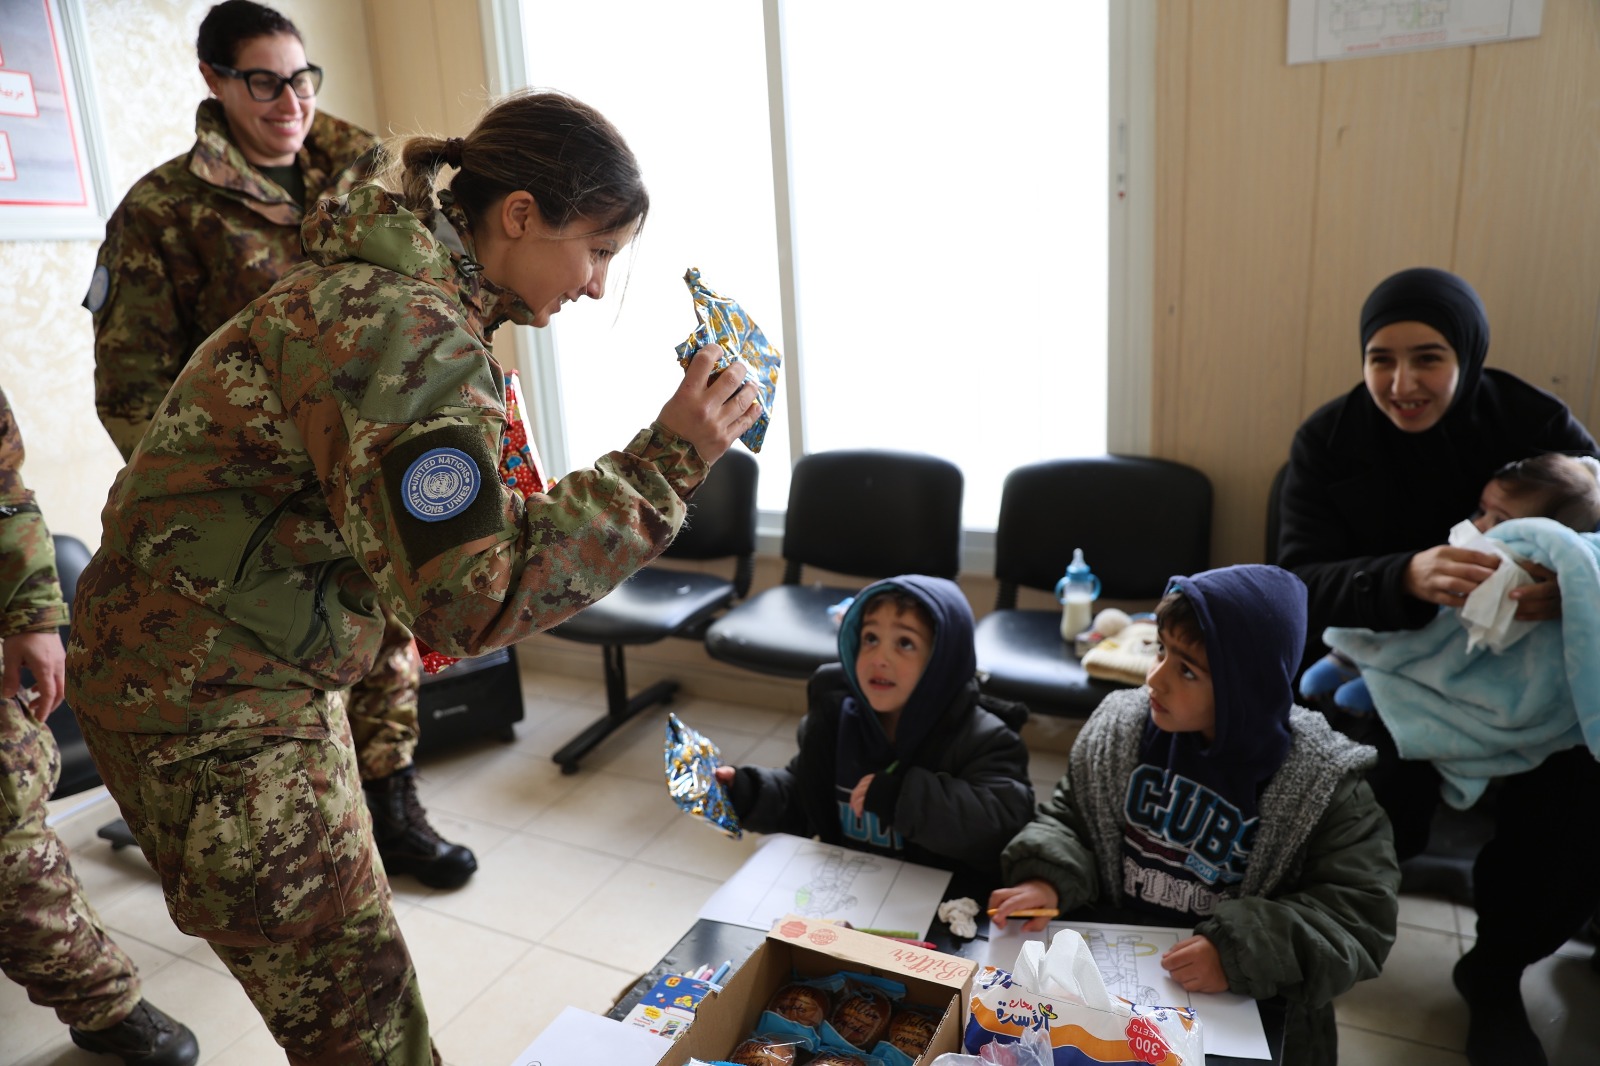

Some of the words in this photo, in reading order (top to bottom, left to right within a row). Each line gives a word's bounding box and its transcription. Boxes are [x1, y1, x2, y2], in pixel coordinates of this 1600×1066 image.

[412, 461, 436, 486] UNITED
[438, 457, 470, 480] NATIONS
[412, 492, 443, 513] NATIONS
[447, 486, 470, 509] UNIES
[1136, 1037, 1161, 1056] 300
